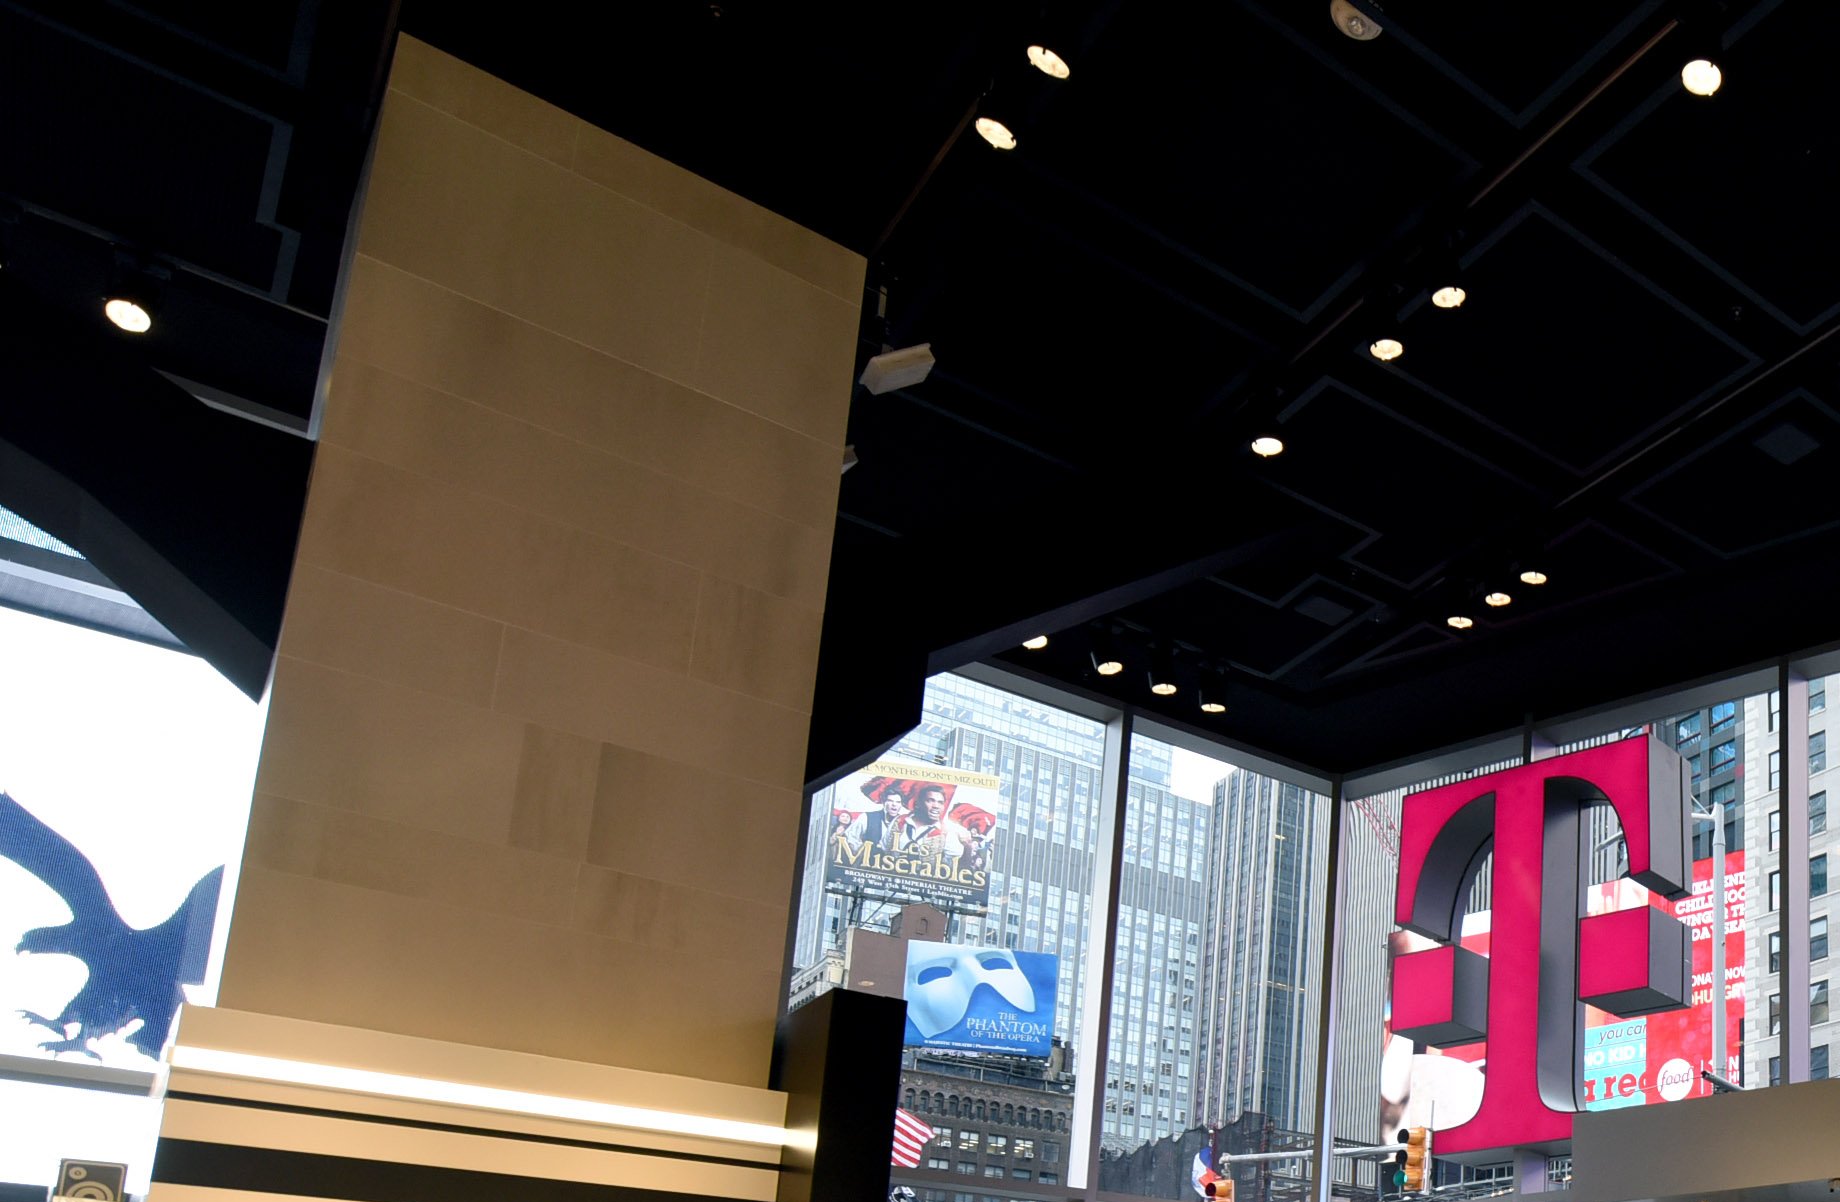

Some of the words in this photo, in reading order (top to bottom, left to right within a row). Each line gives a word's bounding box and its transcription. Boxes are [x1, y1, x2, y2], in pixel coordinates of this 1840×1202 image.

[954, 774, 971, 784] MIZ
[892, 831, 930, 857] Les
[901, 878, 937, 890] IMPERIAL
[938, 884, 972, 896] THEATRE
[998, 1011, 1018, 1021] THE
[966, 1017, 1047, 1036] PHANTOM
[1599, 1026, 1624, 1045] you
[970, 1030, 984, 1038] OF
[986, 1031, 1006, 1040] THE
[1008, 1034, 1041, 1043] OPERA
[1607, 1045, 1635, 1063] KID
[1660, 1065, 1694, 1093] food
